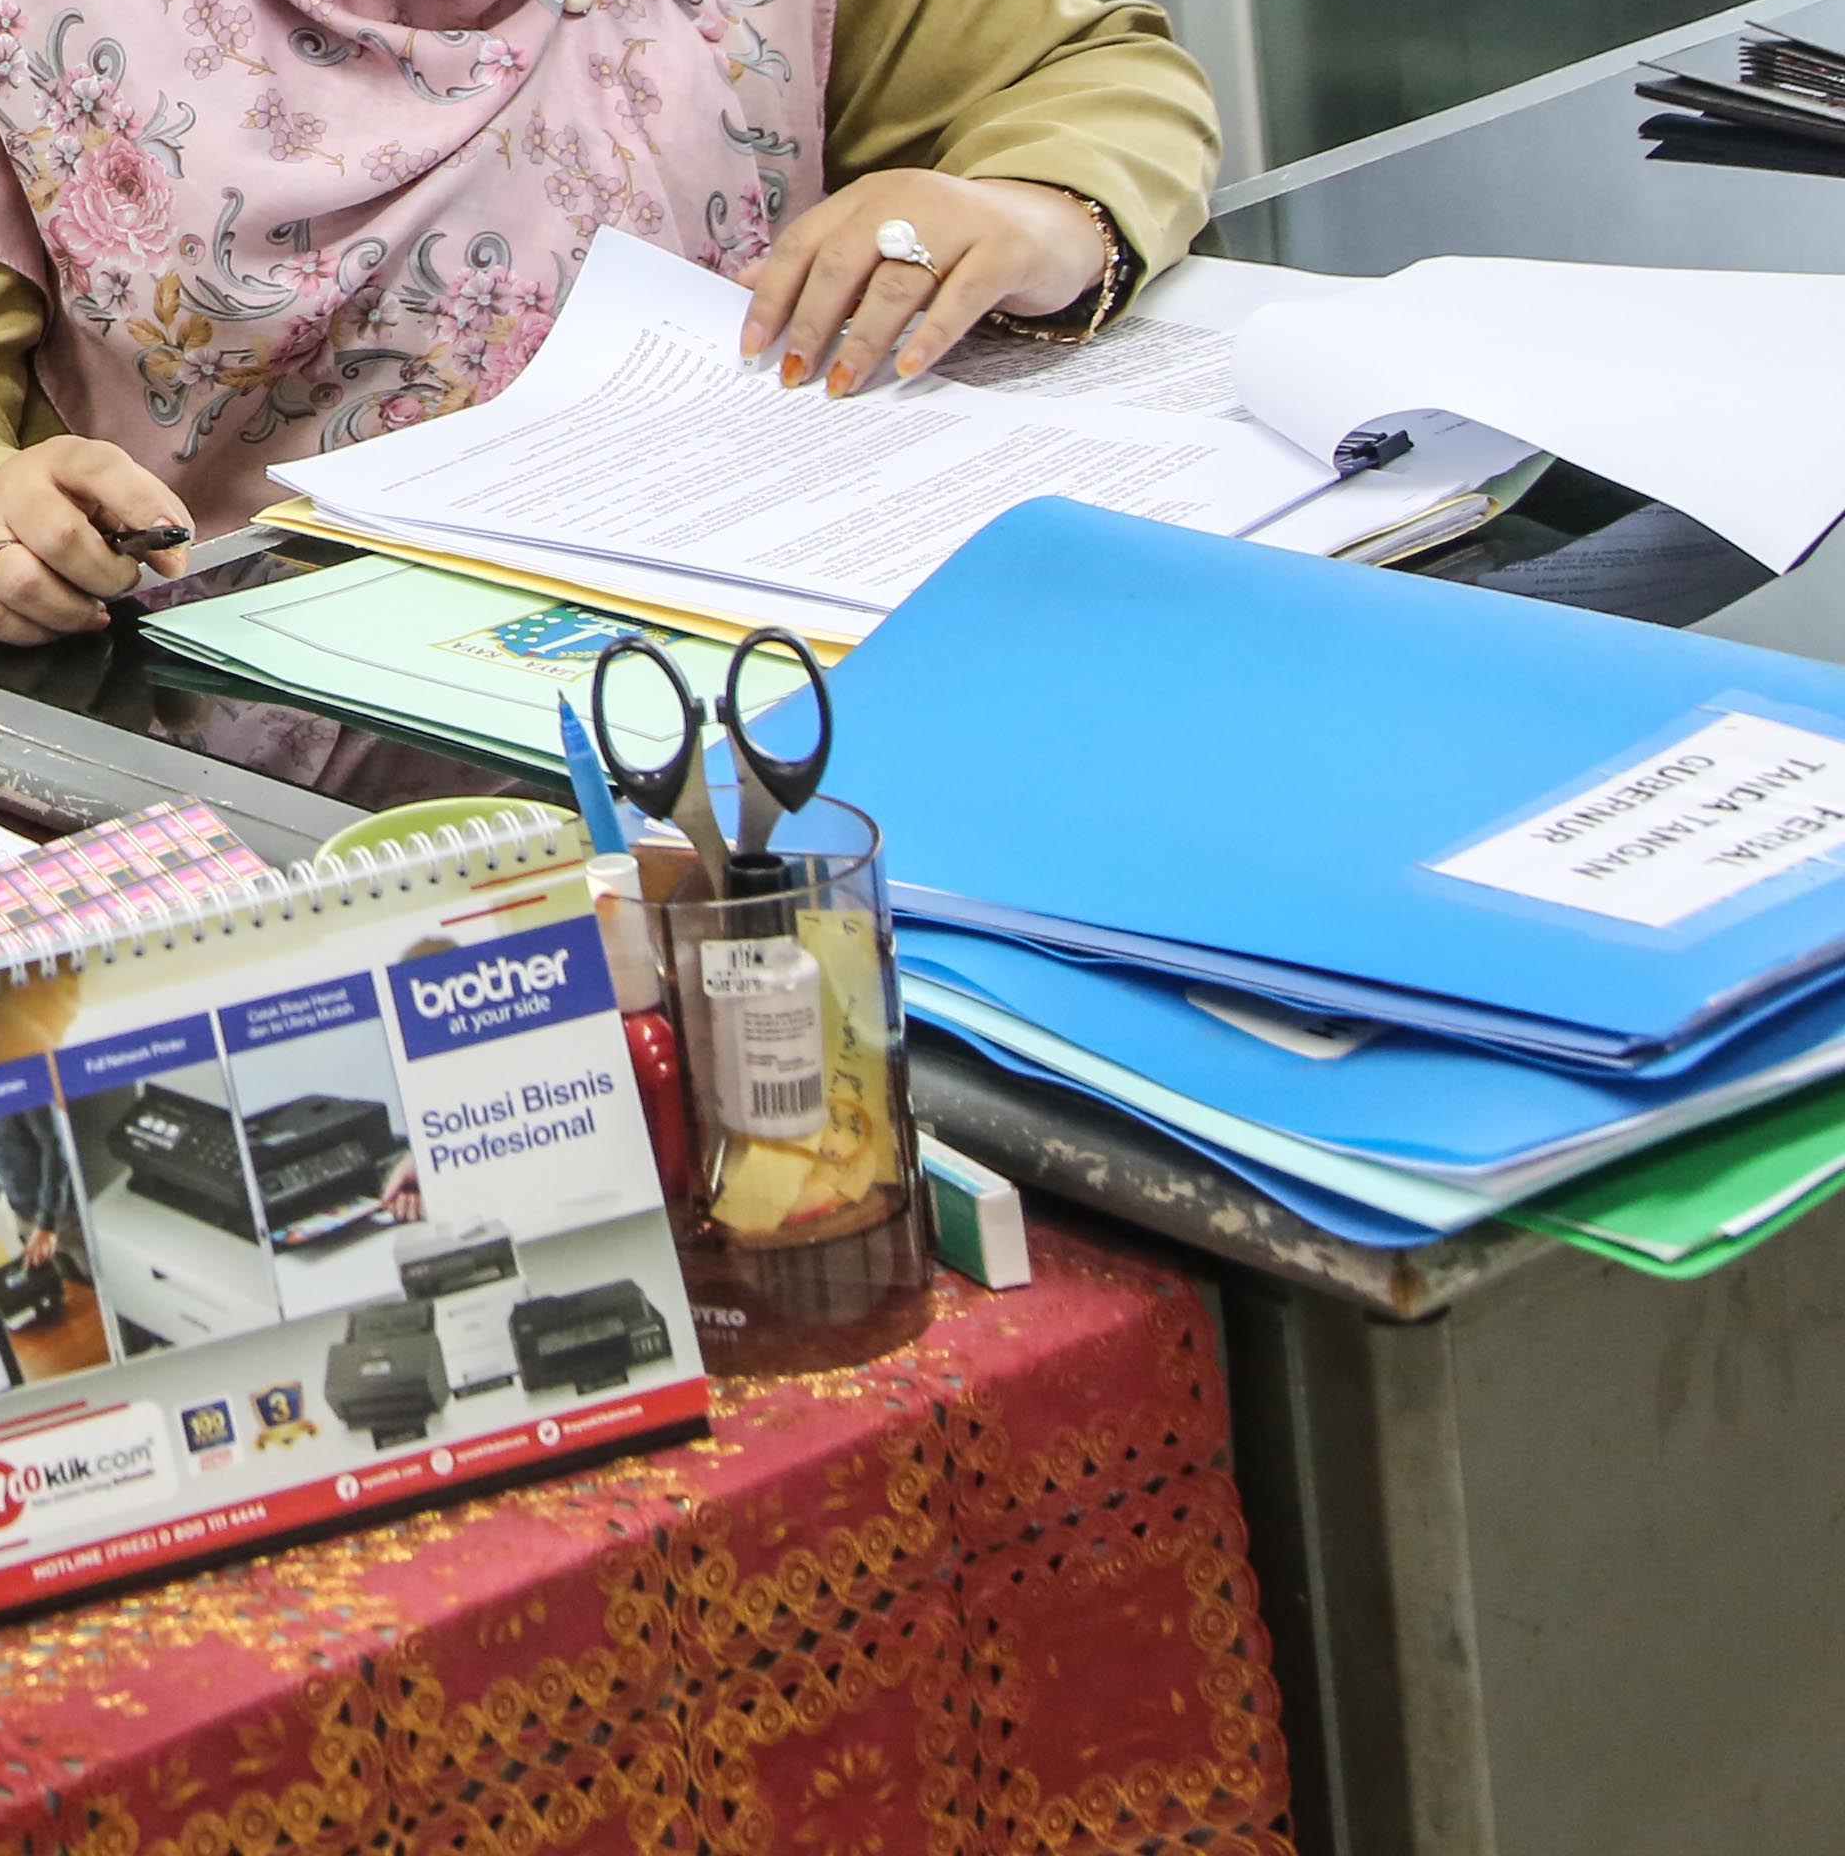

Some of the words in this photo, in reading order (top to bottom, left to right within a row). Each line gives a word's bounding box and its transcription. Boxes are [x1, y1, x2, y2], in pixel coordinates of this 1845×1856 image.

[452, 642, 503, 660] RAYA
[527, 660, 576, 676] JAYA
[1531, 753, 1716, 845] GUBERNUR
[1702, 756, 1827, 813] TANDA
[1571, 813, 1721, 881] TANGAN
[1704, 804, 1845, 867] PERBAL
[410, 948, 569, 1019] brother
[448, 1015, 467, 1035] at
[471, 1007, 510, 1034] your
[514, 994, 552, 1019] side
[422, 1090, 515, 1139] Solusi
[521, 1069, 614, 1114] Bisnis
[429, 1107, 596, 1173] Profesional
